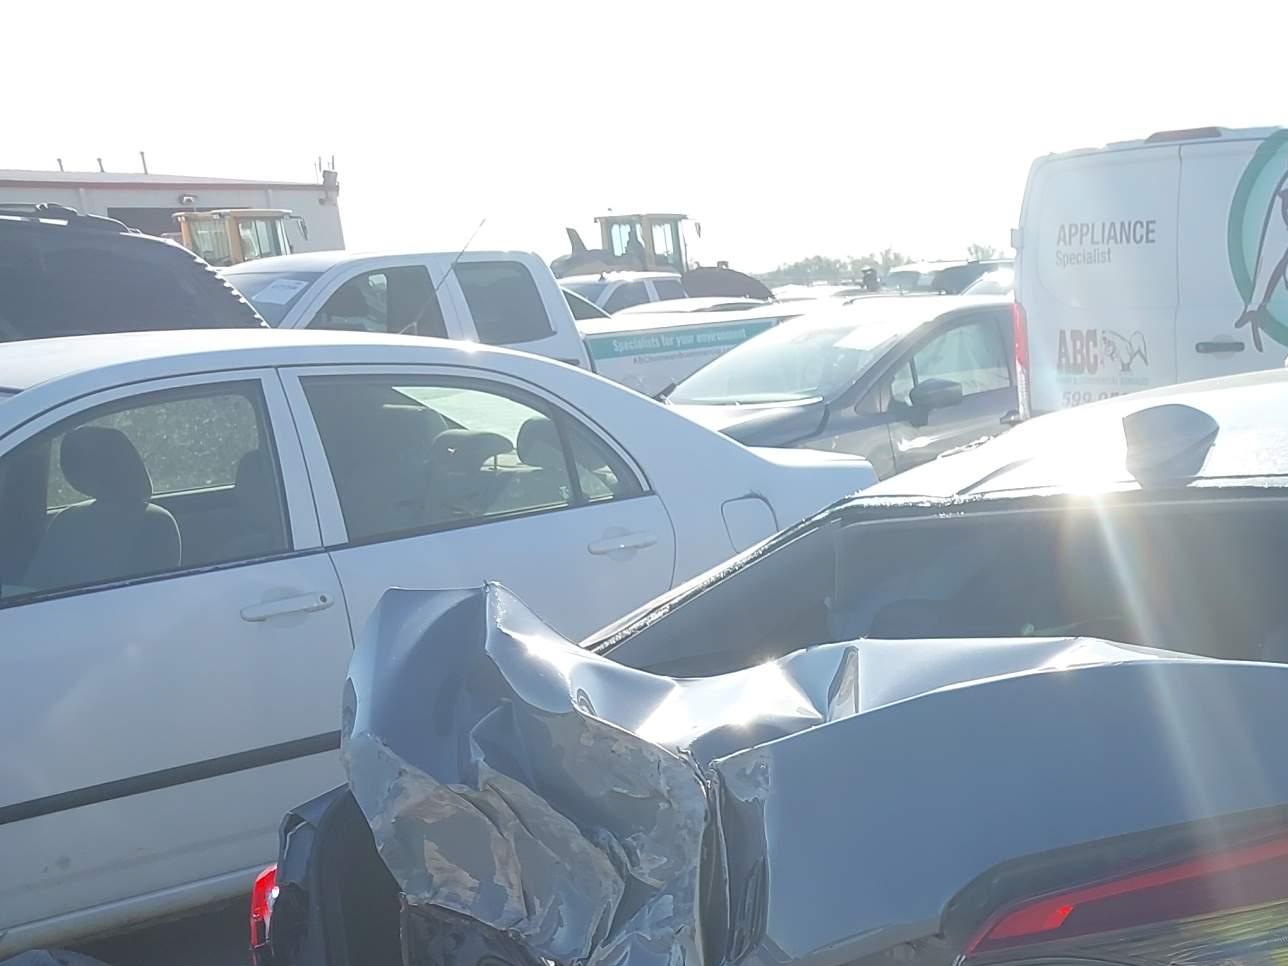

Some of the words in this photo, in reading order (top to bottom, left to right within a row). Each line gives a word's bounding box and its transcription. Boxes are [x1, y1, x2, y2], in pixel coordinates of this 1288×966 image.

[1056, 219, 1156, 246] APPLIANCE
[1055, 247, 1111, 269] Specialist
[612, 335, 660, 352] Specialists
[1056, 328, 1099, 374] ABC
